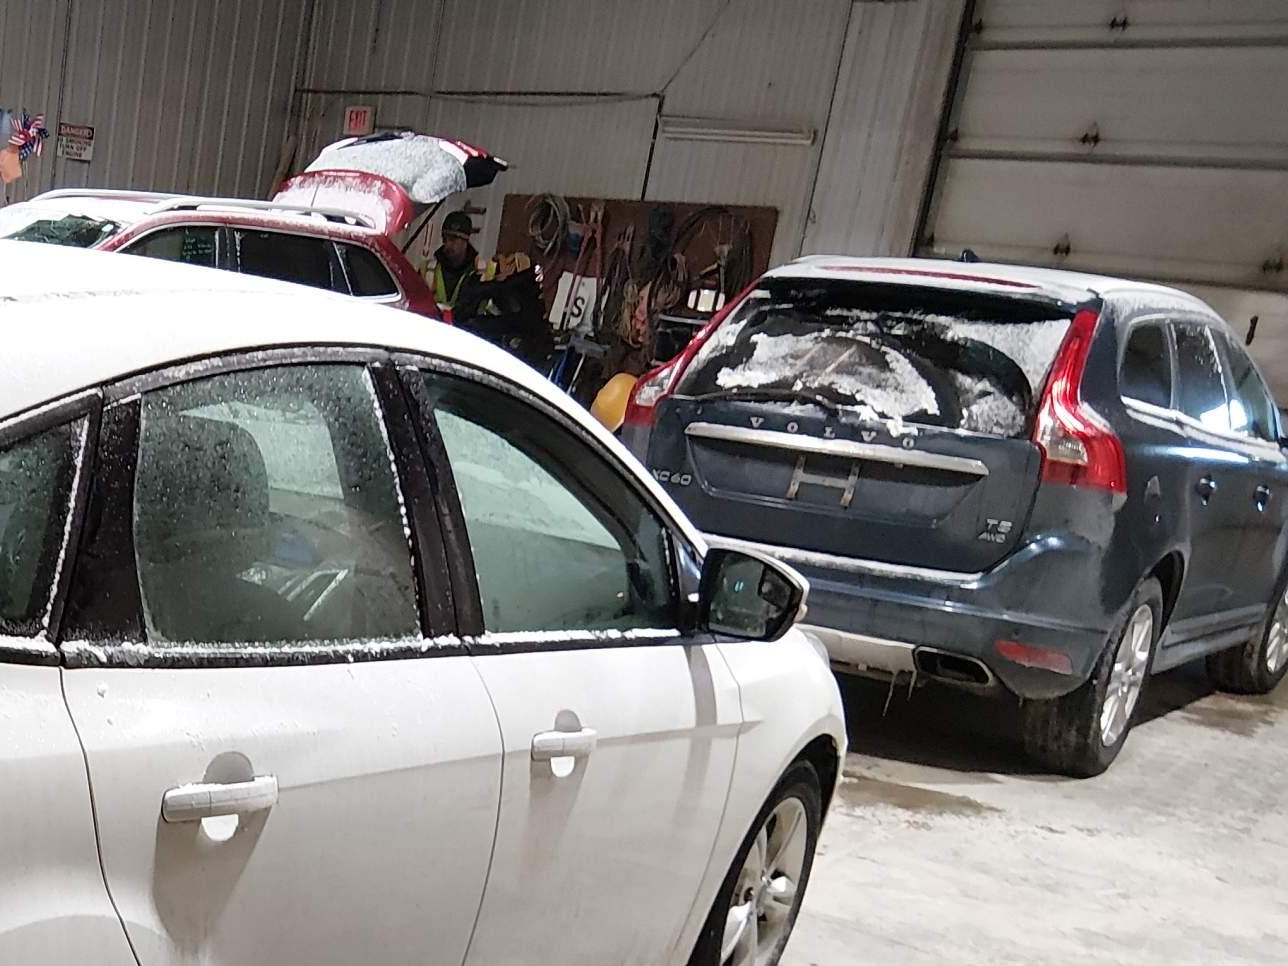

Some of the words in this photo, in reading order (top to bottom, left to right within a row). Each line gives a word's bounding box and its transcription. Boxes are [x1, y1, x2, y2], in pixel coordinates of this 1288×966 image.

[572, 296, 585, 318] S
[750, 416, 915, 449] VOLVO
[652, 468, 692, 485] XC60
